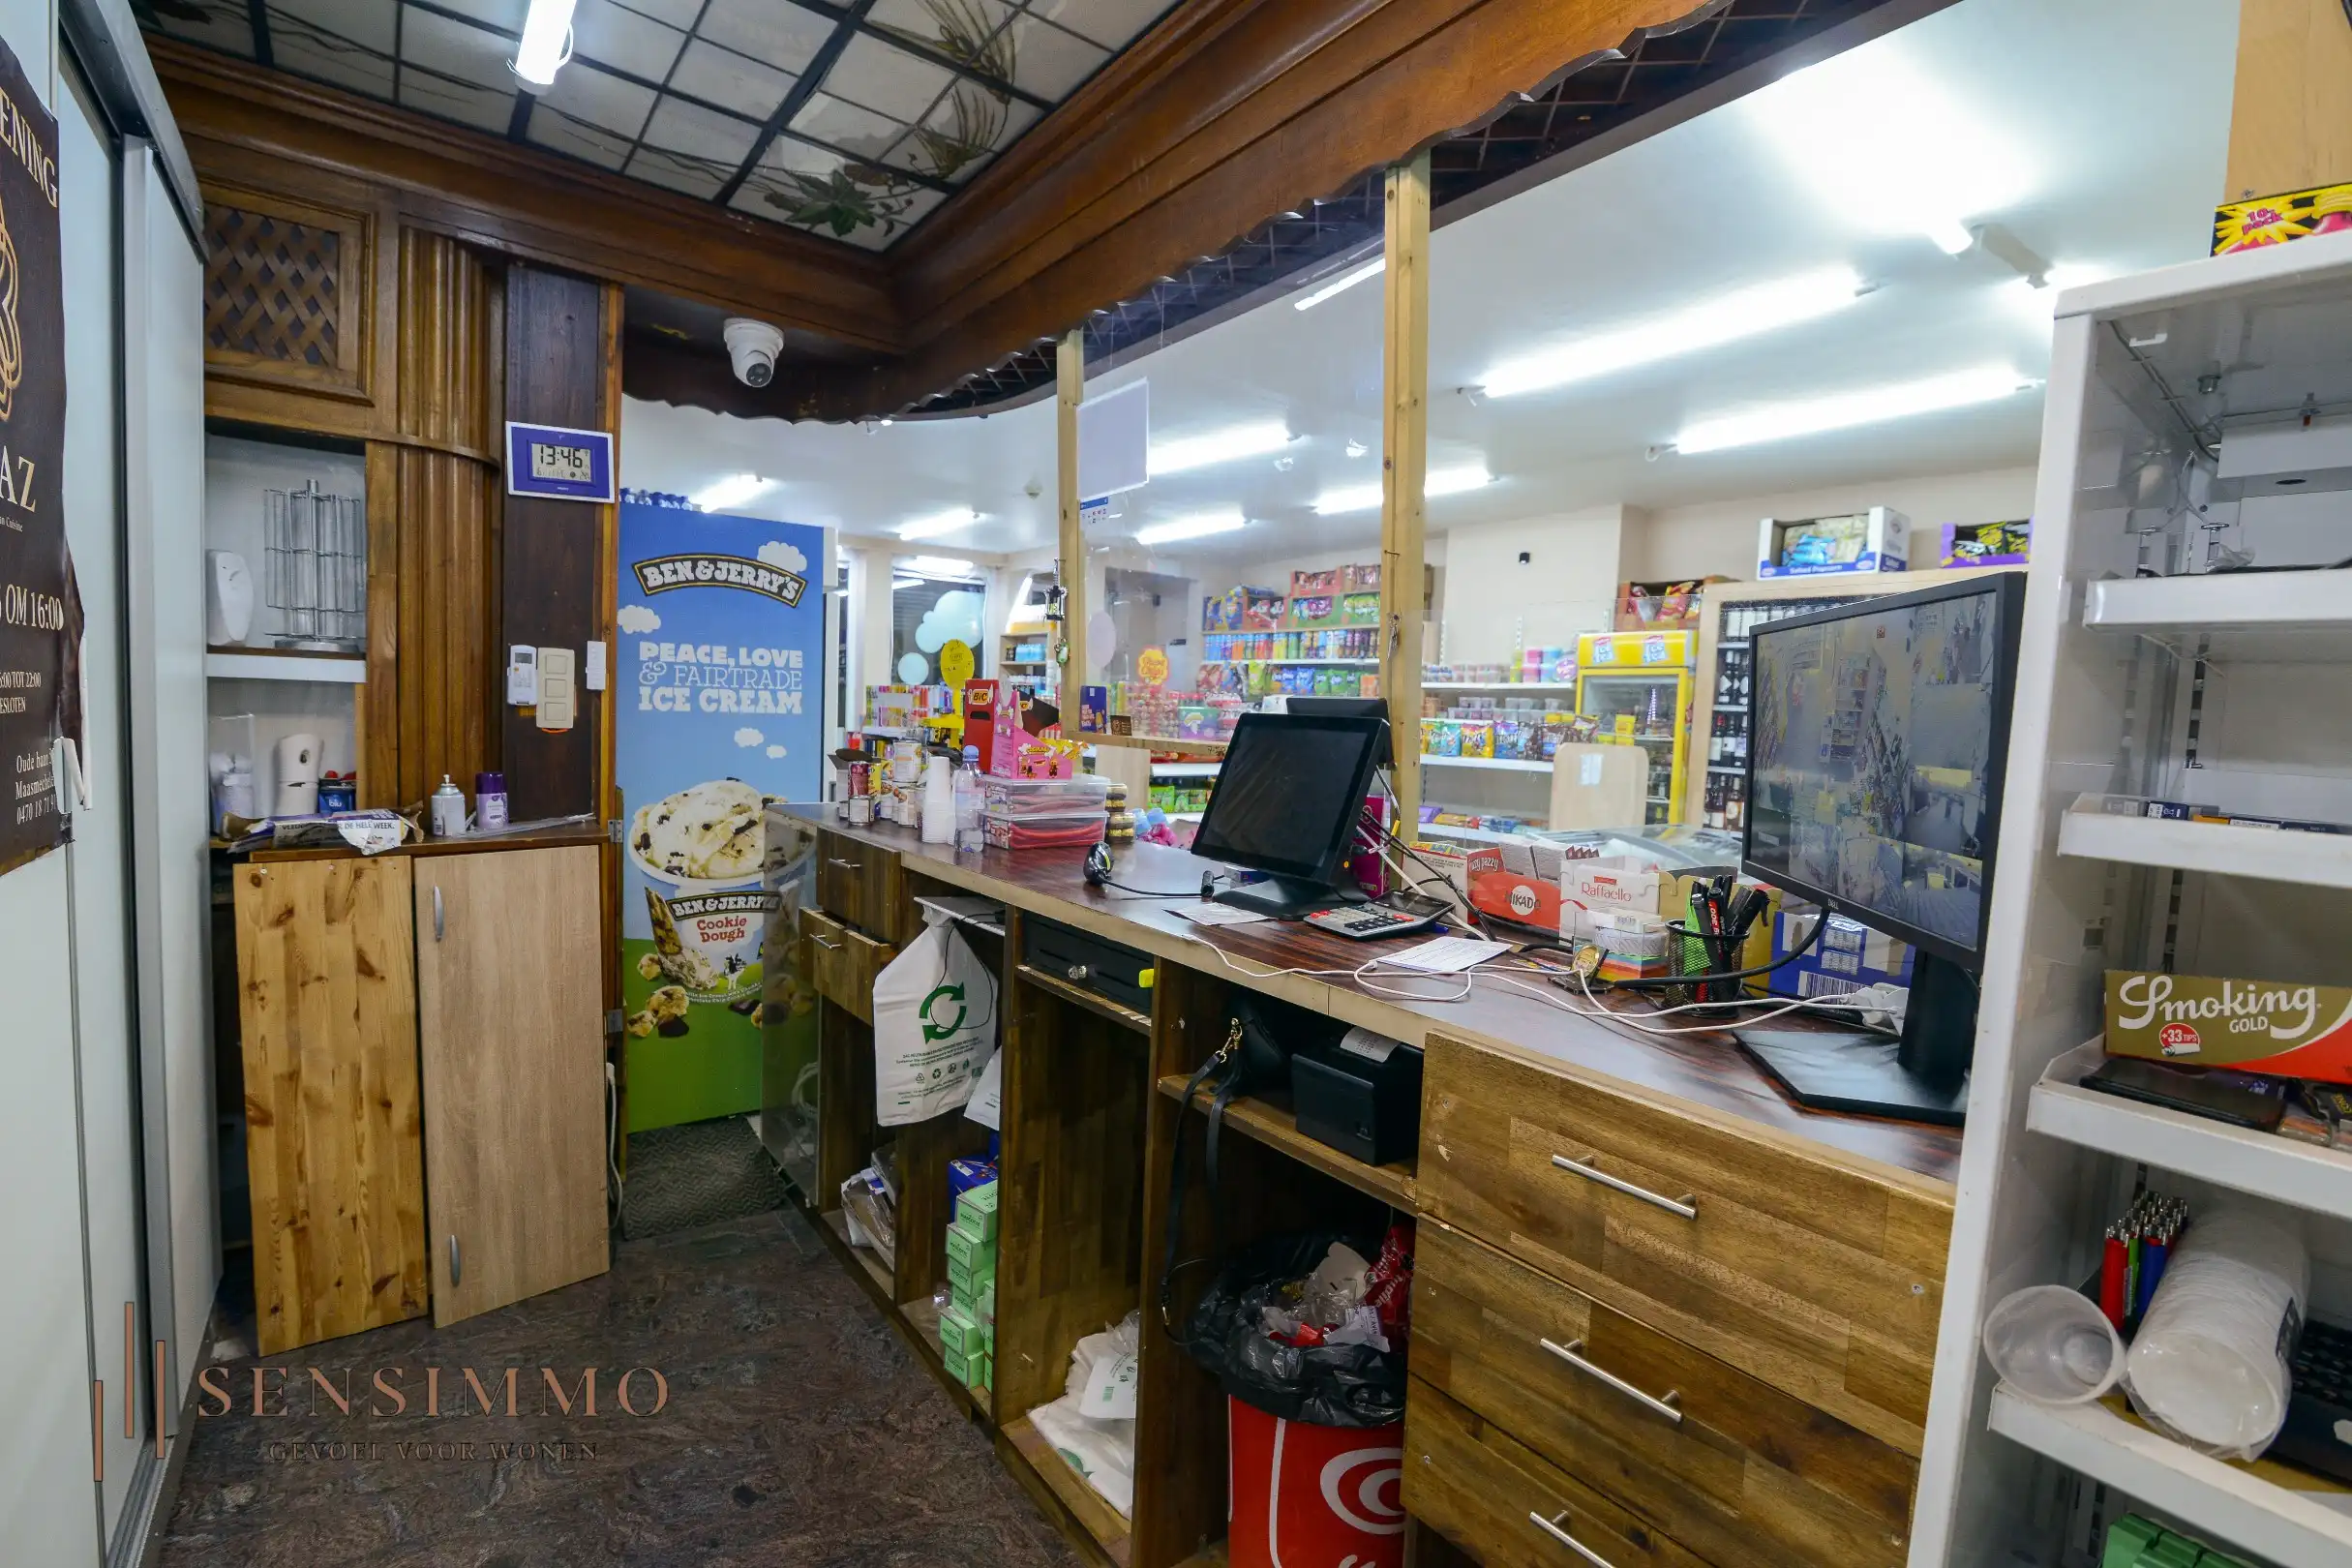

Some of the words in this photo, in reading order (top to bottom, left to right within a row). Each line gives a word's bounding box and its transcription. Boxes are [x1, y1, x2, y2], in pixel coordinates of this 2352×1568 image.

[2247, 208, 2271, 222] 10
[540, 445, 583, 468] 13:46
[642, 561, 694, 588] BEN
[695, 559, 715, 581] &
[713, 561, 799, 601] JERRY'S
[5, 584, 28, 626] OM
[30, 591, 65, 631] 16:00
[639, 641, 736, 668] PEACE,
[739, 647, 803, 669] LOVE
[639, 661, 667, 685] &
[674, 665, 803, 691] FAIRTRADE
[639, 686, 691, 712] ICE
[699, 688, 803, 714] CREAM
[16, 753, 35, 773] Oude
[328, 798, 343, 807] blu
[16, 802, 33, 825] 0470
[1581, 882, 1632, 902] Raffaello
[671, 900, 706, 917] BEN
[705, 897, 719, 911] &
[697, 915, 748, 931] Cookie
[700, 927, 745, 943] Dough
[2118, 975, 2316, 1040] Smoking
[2229, 1016, 2269, 1034] GOLD
[2183, 1034, 2197, 1042] TIPS
